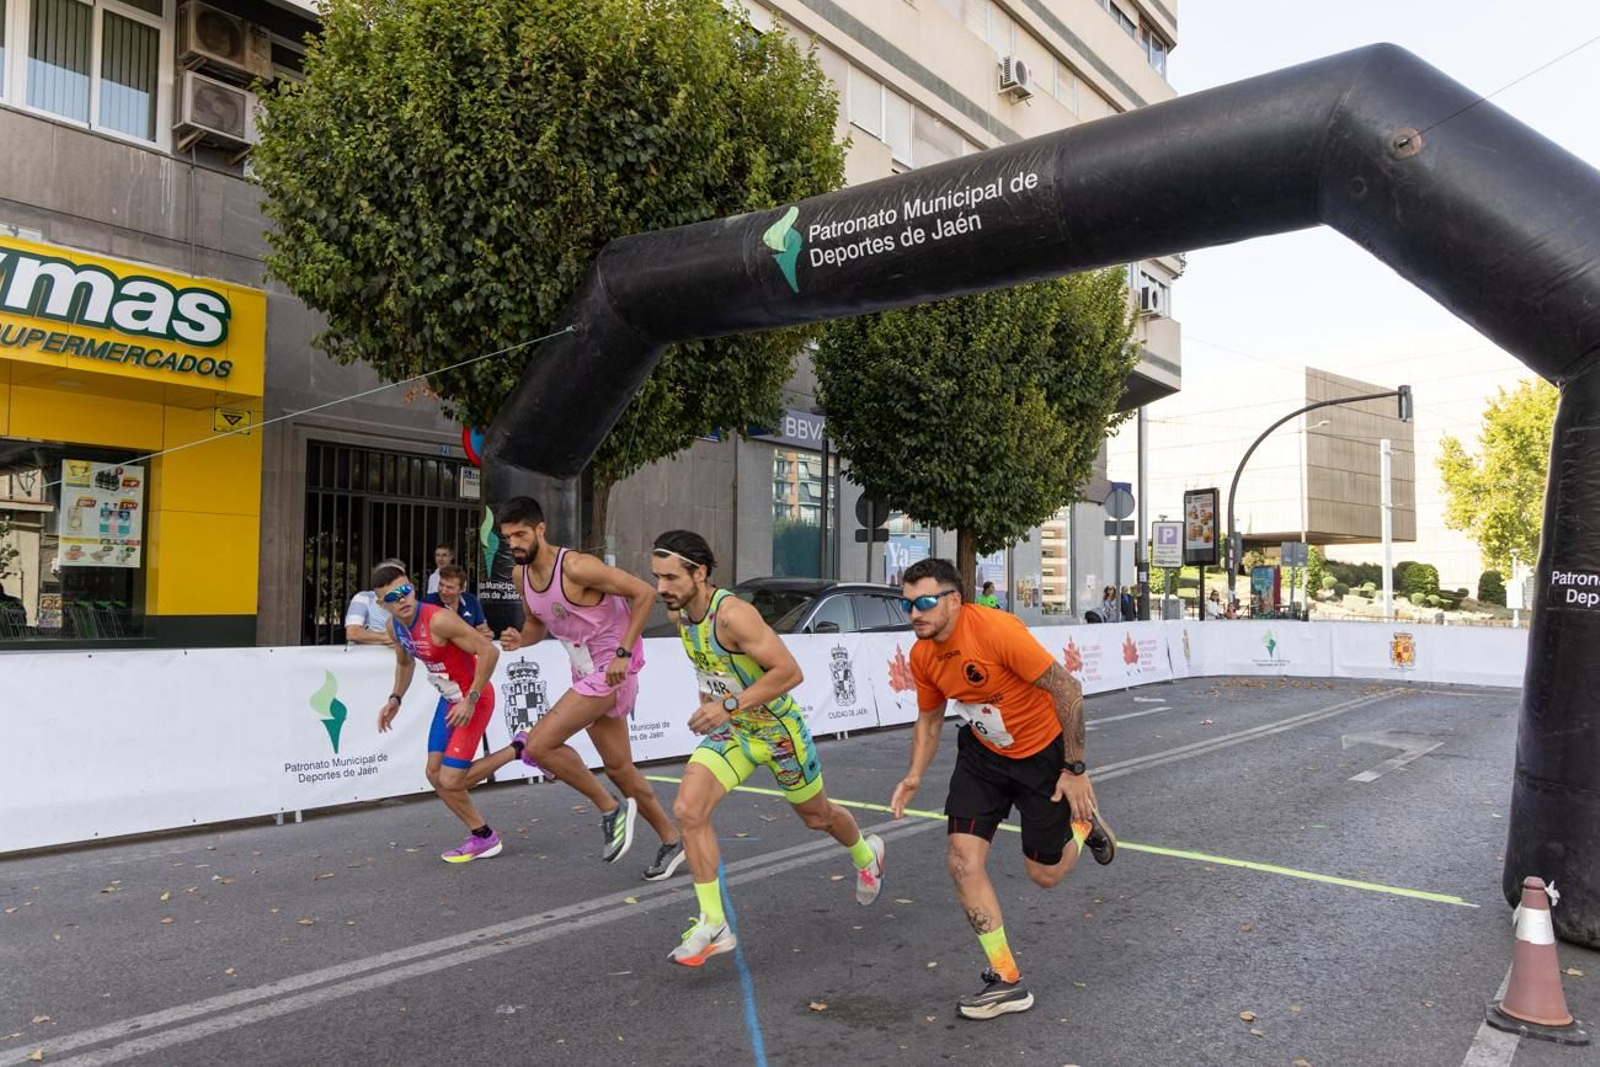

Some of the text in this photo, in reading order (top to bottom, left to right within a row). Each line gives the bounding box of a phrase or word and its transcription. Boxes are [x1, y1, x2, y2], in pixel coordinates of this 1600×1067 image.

[808, 171, 1039, 243] Patronato Municipal de
[809, 211, 983, 267] Deportes de Jaén
[0, 251, 227, 344] mas
[1162, 528, 1174, 543] P
[888, 543, 909, 568] Ya
[1551, 571, 1600, 586] Patron
[631, 721, 670, 732] Municipal de
[639, 733, 648, 741] de
[649, 730, 664, 740] Jaén
[284, 752, 388, 773] Patronato Municipal de
[298, 764, 379, 783] Deportes de Jaén
